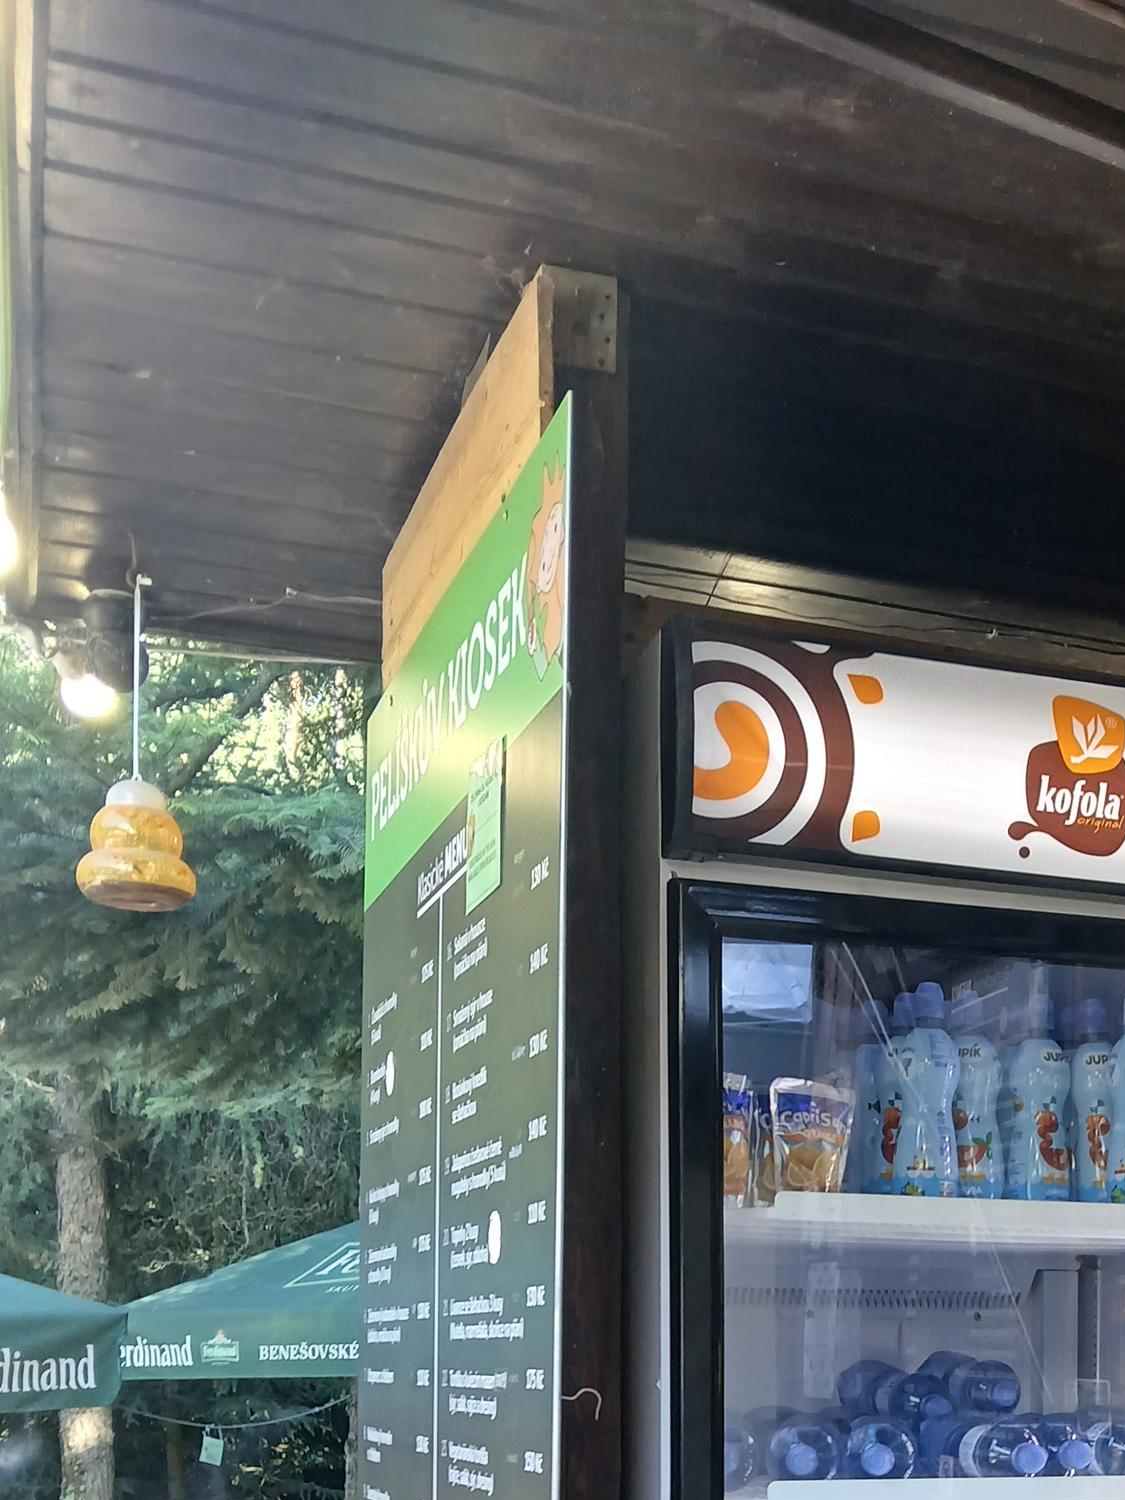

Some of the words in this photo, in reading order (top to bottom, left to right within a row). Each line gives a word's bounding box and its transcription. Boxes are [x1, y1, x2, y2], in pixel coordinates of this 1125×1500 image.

[447, 553, 528, 739] KIOSEK
[1036, 775, 1121, 826] kofola
[1077, 815, 1125, 834] original
[1086, 1054, 1109, 1066] JUP
[120, 1335, 193, 1368] rdinand
[259, 1341, 360, 1361] BENEŠOVSKÉ
